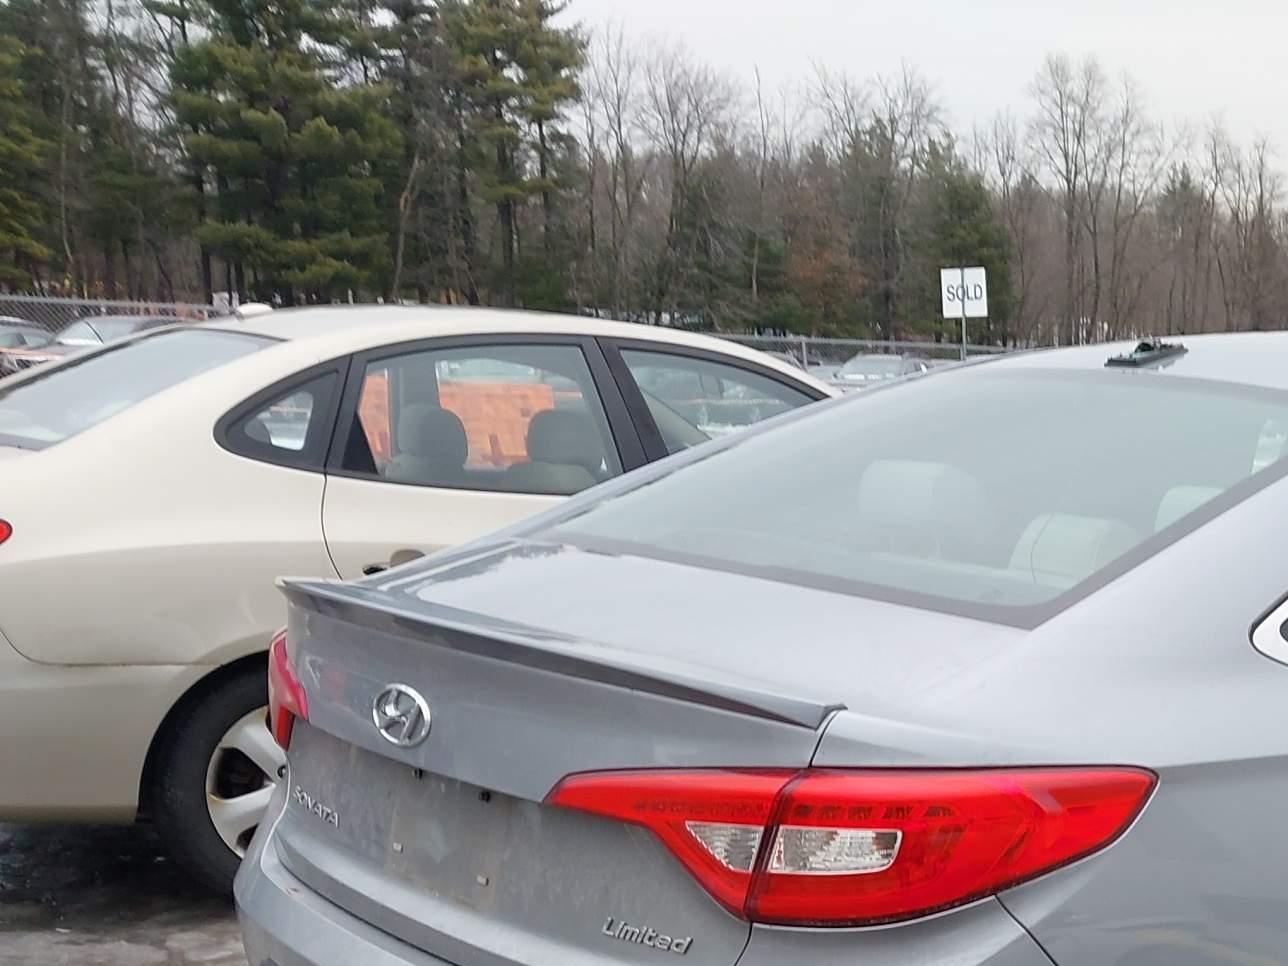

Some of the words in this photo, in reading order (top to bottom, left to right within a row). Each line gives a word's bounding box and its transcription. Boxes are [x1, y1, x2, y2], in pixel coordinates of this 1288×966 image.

[946, 284, 983, 302] SOLD
[293, 785, 340, 828] SONATA
[602, 917, 694, 954] Limited
